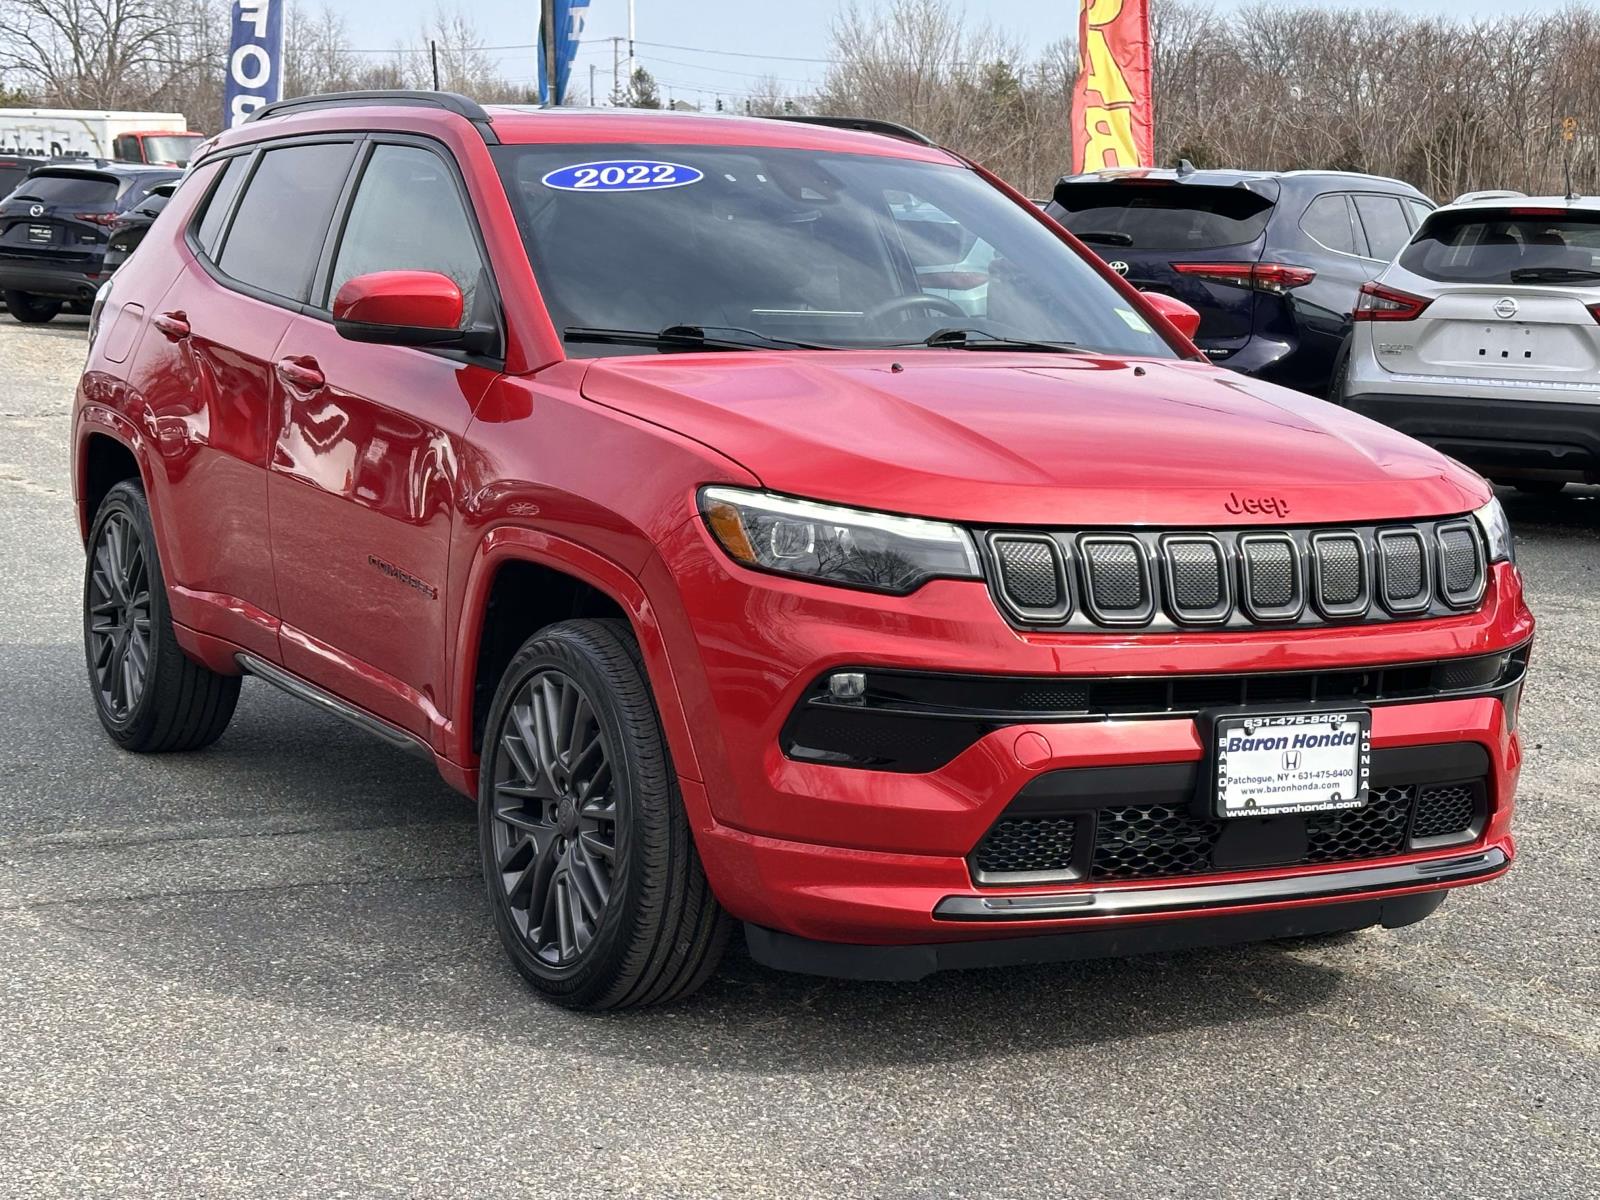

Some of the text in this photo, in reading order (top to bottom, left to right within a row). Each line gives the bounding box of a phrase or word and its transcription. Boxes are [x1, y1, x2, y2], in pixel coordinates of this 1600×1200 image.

[574, 165, 677, 188] 2022
[1224, 492, 1291, 518] Jeep
[1244, 714, 1348, 728] 631-475-8400
[1227, 731, 1357, 753] Baron Honda
[1218, 737, 1228, 801] BARON
[1360, 729, 1371, 790] HONDA
[1227, 775, 1275, 785] Patchogue,
[1277, 773, 1290, 782] NY
[1240, 781, 1341, 795] www.baronhonda.com
[1226, 800, 1362, 818] www.baronhonda.com
